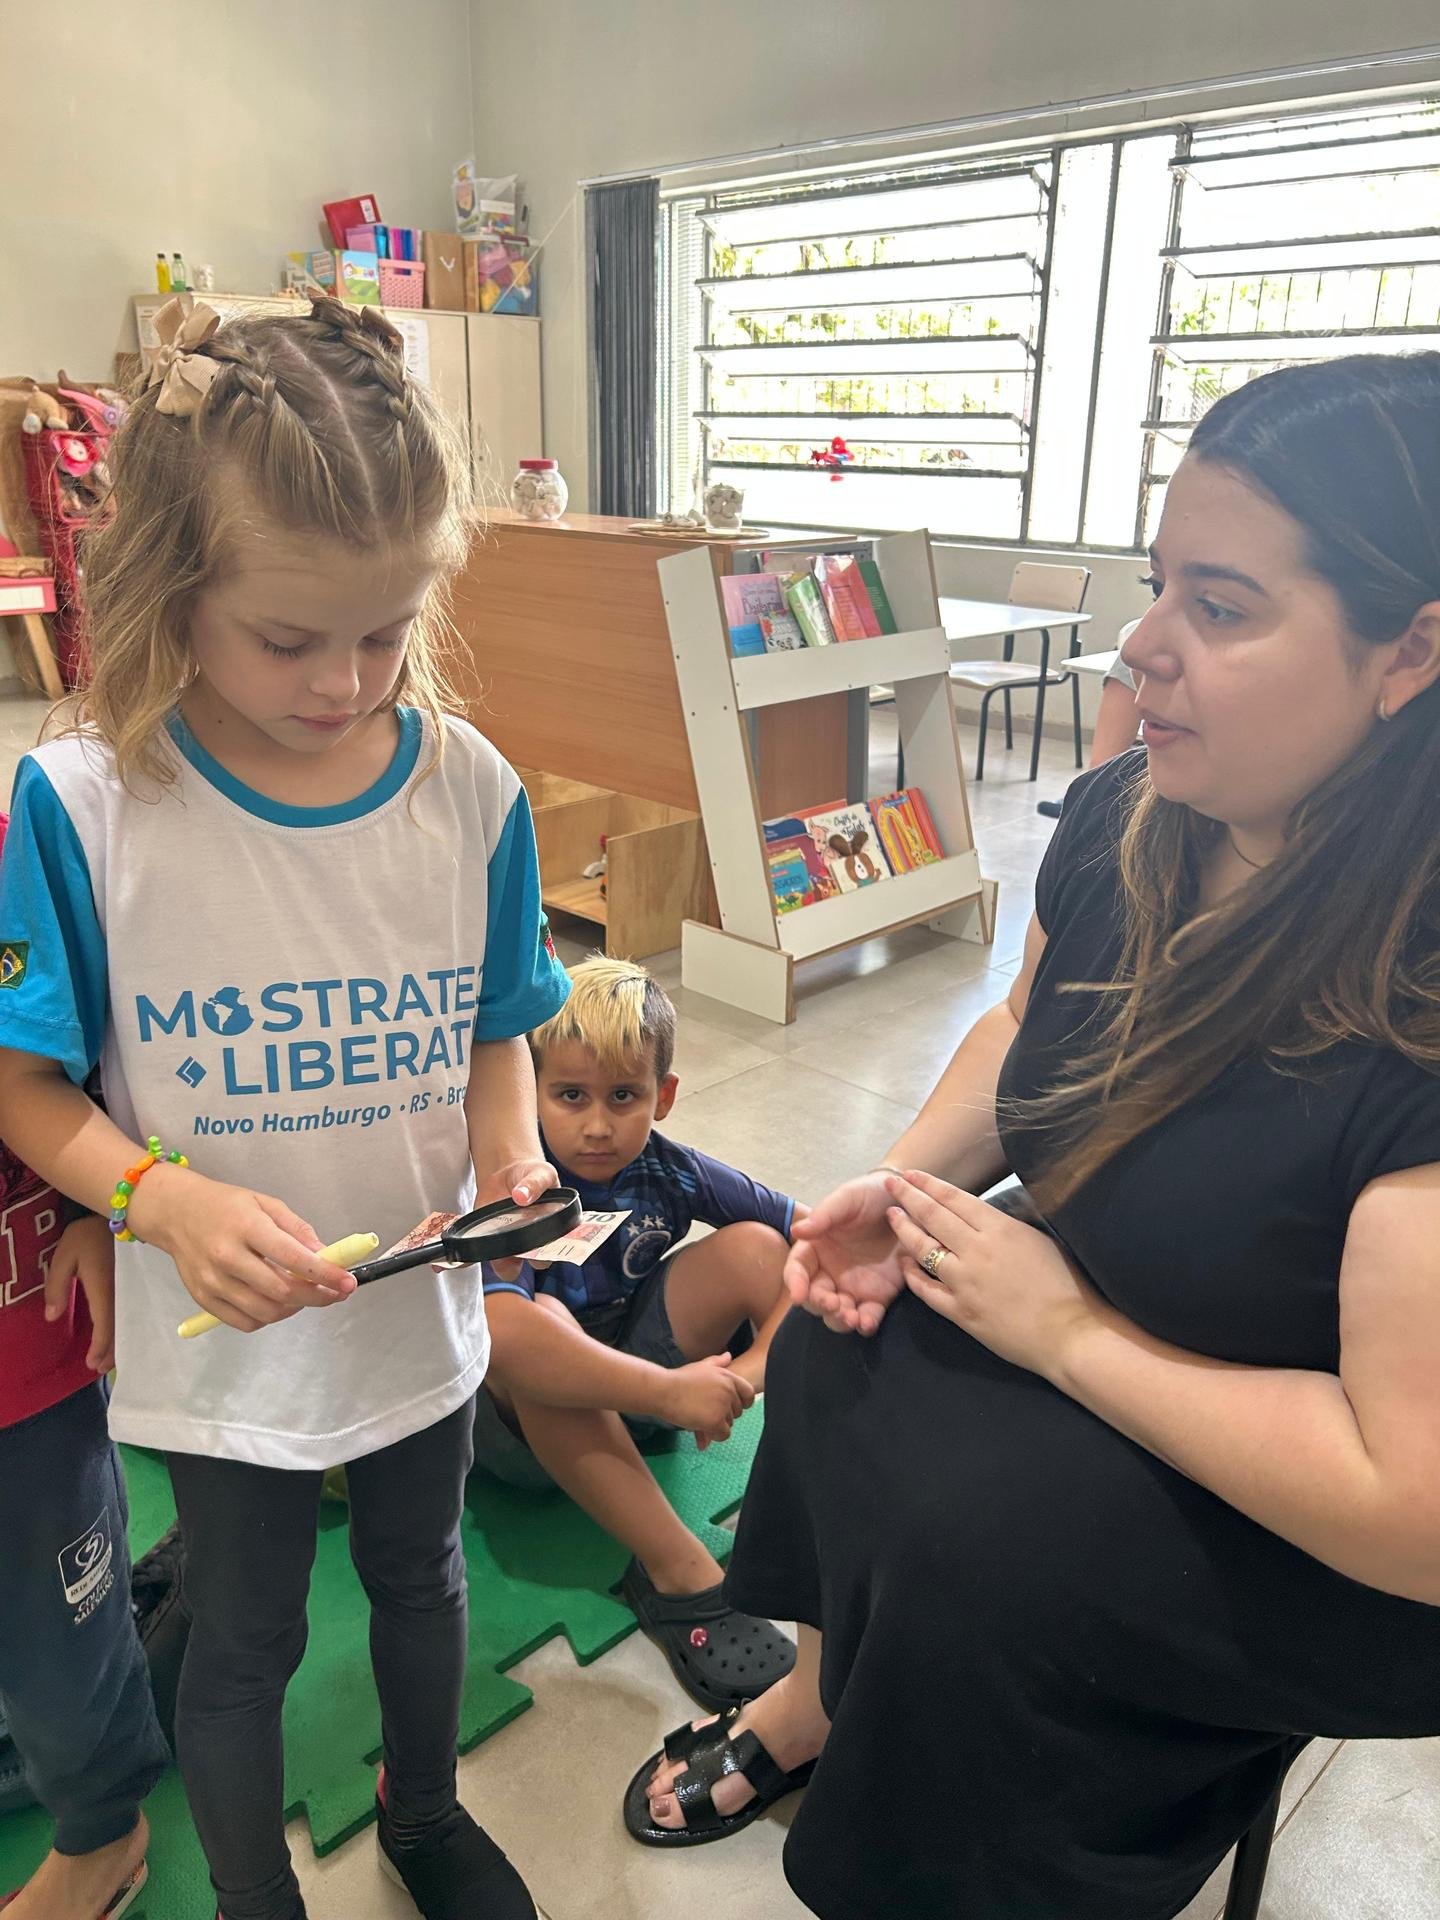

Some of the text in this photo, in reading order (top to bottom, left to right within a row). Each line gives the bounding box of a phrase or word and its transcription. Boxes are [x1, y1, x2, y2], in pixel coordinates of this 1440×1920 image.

[135, 966, 482, 1042] MOSTRATE
[222, 1016, 474, 1096] LIBERAT
[193, 1112, 254, 1136] Novo
[262, 1104, 391, 1134] Hamburgo
[410, 1092, 430, 1114] RS
